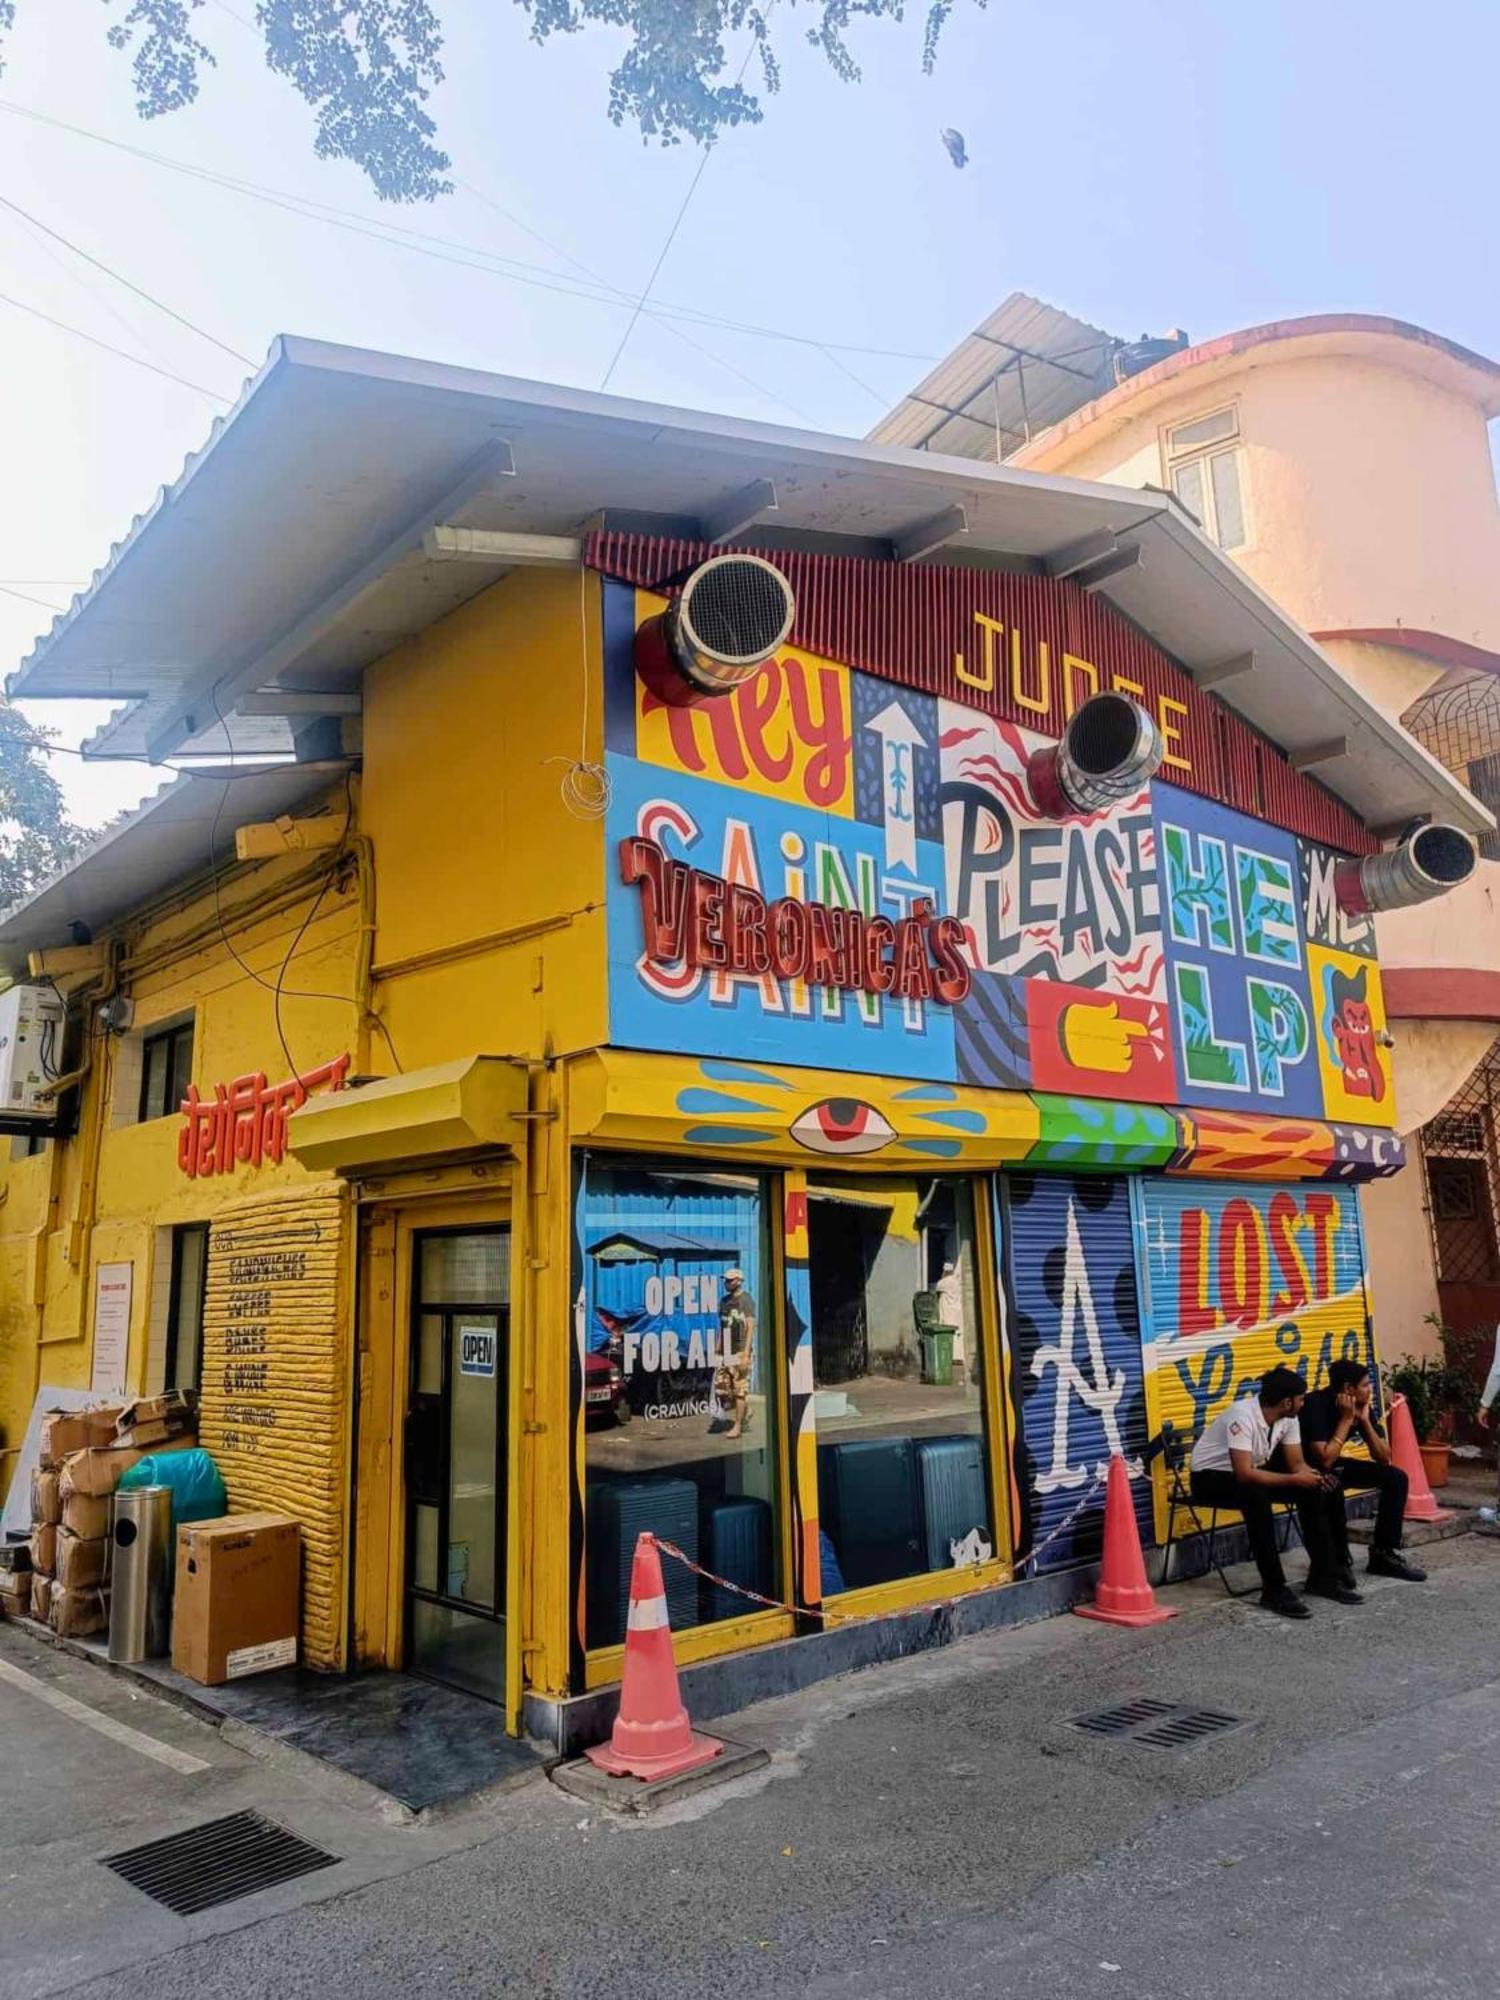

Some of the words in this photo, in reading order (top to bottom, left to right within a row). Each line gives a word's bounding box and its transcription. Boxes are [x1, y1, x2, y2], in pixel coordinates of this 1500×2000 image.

[955, 611, 1191, 771] JUDE
[939, 780, 1162, 966] PLEASE
[619, 836, 973, 1006] VERONICA'S
[229, 1253, 307, 1285] SANDWICHES
[1177, 1191, 1341, 1339] LOST
[227, 1290, 272, 1318] COFFEE
[644, 1275, 718, 1316] OPEN
[463, 1334, 492, 1364] OPEN
[623, 1331, 681, 1374] FOR
[687, 1327, 741, 1369] ALL
[644, 1398, 722, 1421] (CRAVINGS)
